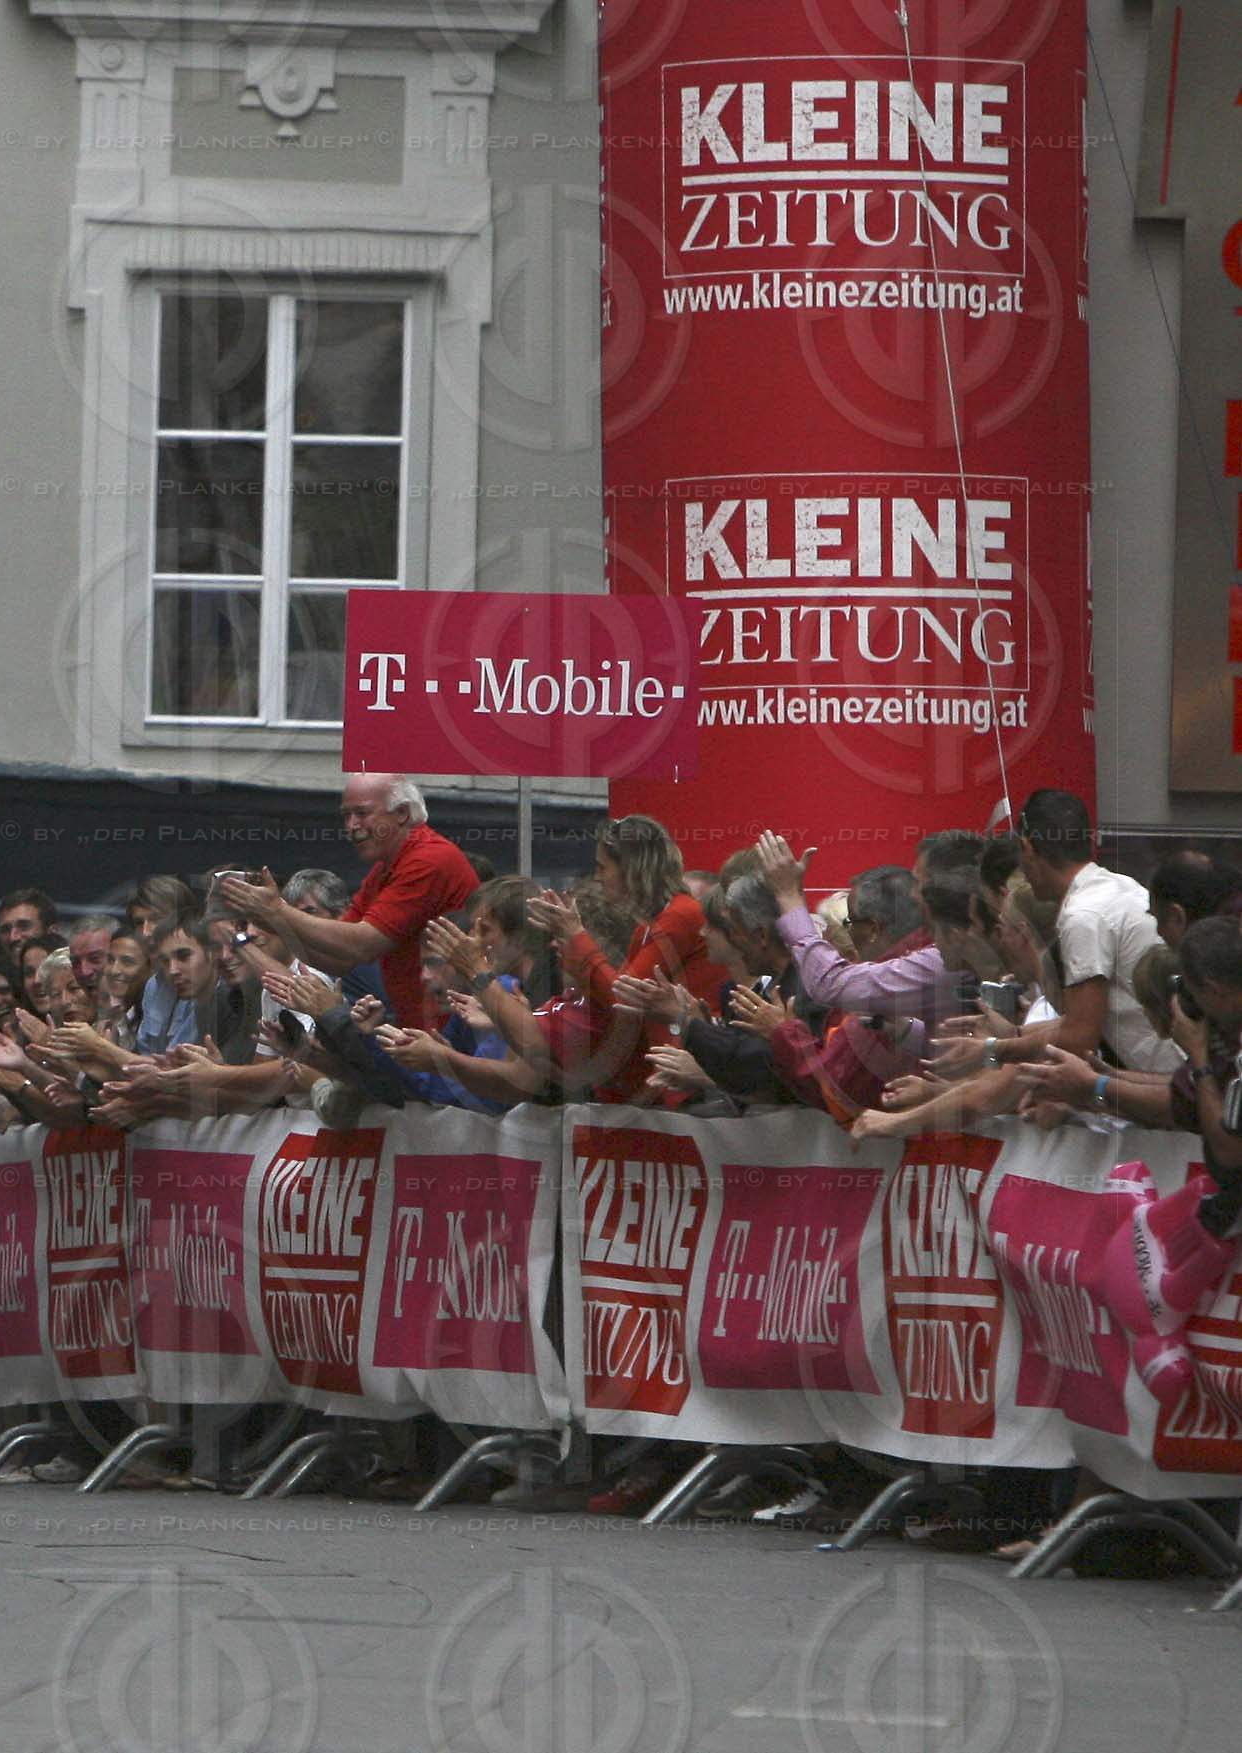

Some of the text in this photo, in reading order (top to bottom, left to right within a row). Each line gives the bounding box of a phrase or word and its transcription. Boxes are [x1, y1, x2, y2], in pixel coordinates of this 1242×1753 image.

[681, 80, 1010, 166] KLEINE
[680, 189, 1011, 253] ZEITUNG
[663, 273, 1024, 320] www.kleinezeitung.at
[685, 498, 1012, 582] KLEINE
[698, 606, 1015, 667] ZEITUNG
[698, 687, 1028, 734] ww.kleinezeitung.at
[47, 1151, 119, 1248] KLEINE
[263, 1157, 374, 1256] KLEINE
[573, 1156, 703, 1270] KLEINE
[265, 1290, 356, 1366] ZEITUNG
[582, 1300, 686, 1385] ITUNG
